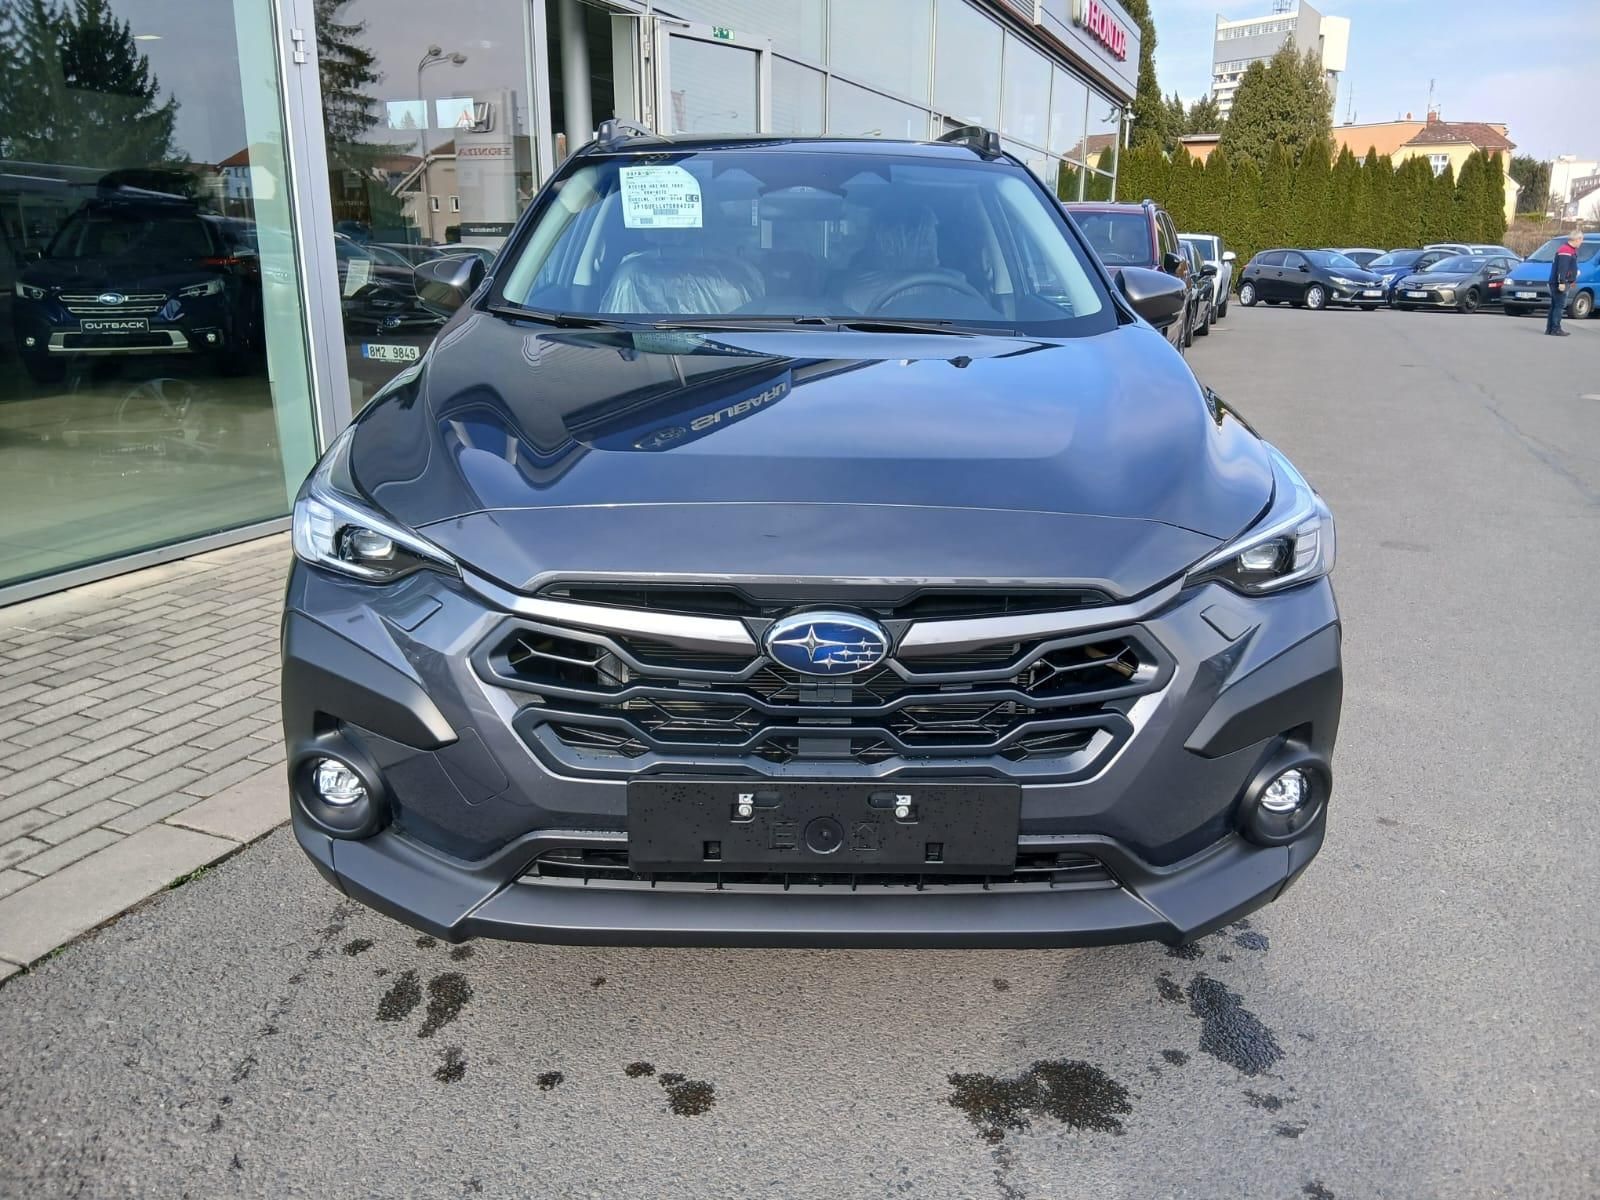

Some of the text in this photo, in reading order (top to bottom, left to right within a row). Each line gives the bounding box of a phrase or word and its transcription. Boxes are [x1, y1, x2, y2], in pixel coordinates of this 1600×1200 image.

[1089, 0, 1127, 61] HONDA
[85, 321, 144, 330] OUTBACK
[369, 346, 416, 359] 8M2 9849
